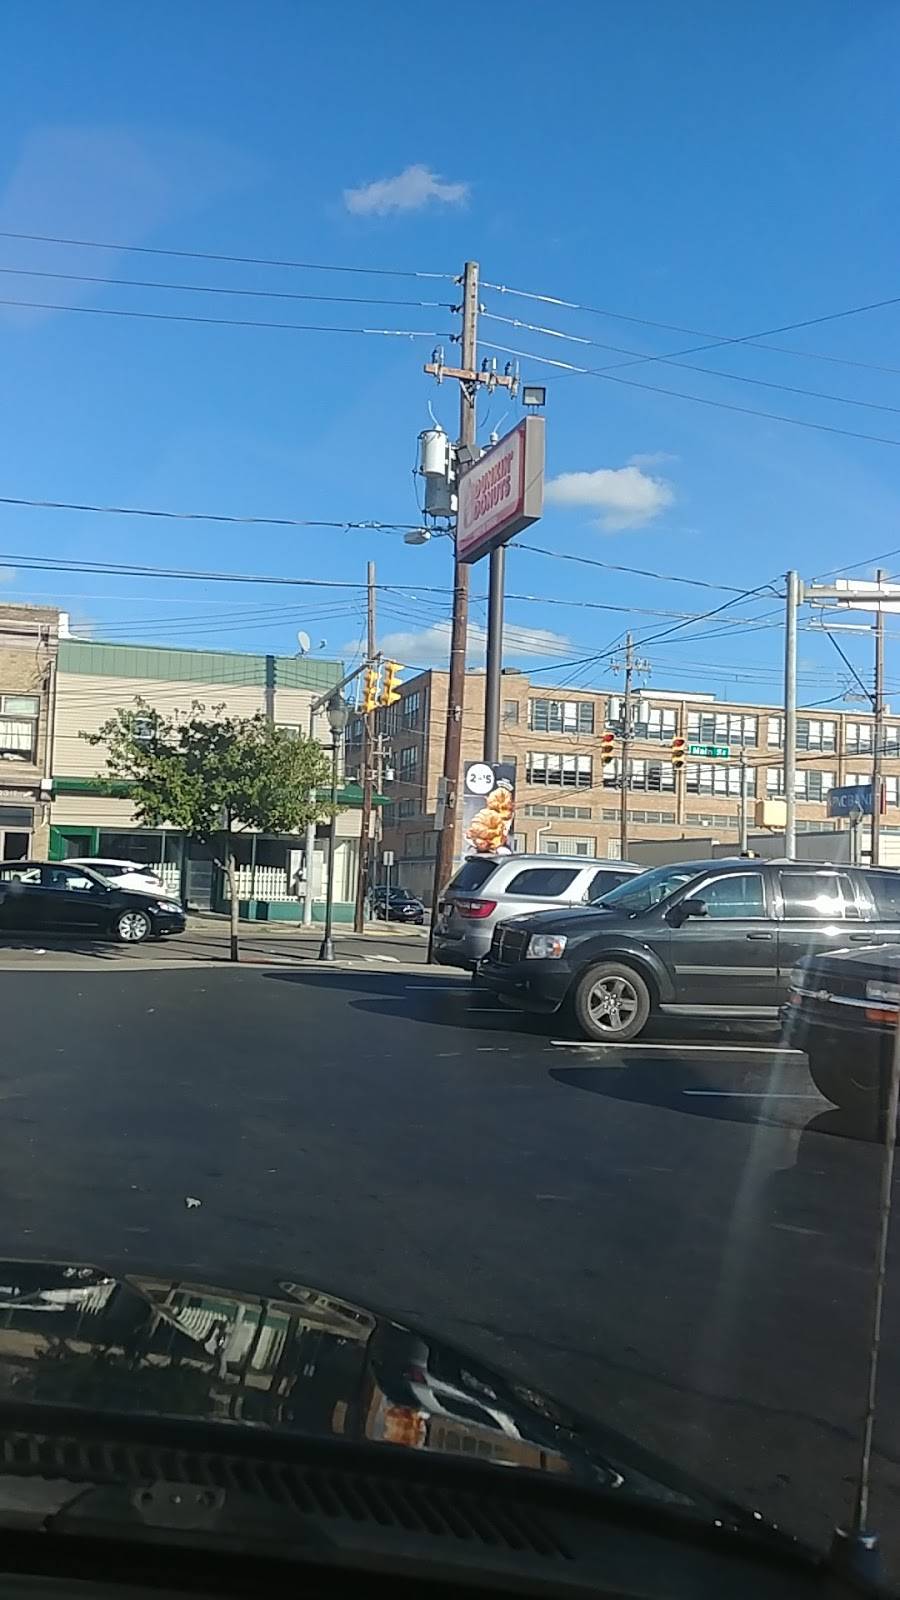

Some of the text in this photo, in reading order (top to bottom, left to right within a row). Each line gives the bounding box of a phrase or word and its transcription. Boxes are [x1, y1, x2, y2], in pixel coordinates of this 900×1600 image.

[472, 450, 514, 500] DUNKIN'
[473, 474, 511, 521] DONUTS
[692, 746, 713, 756] Main
